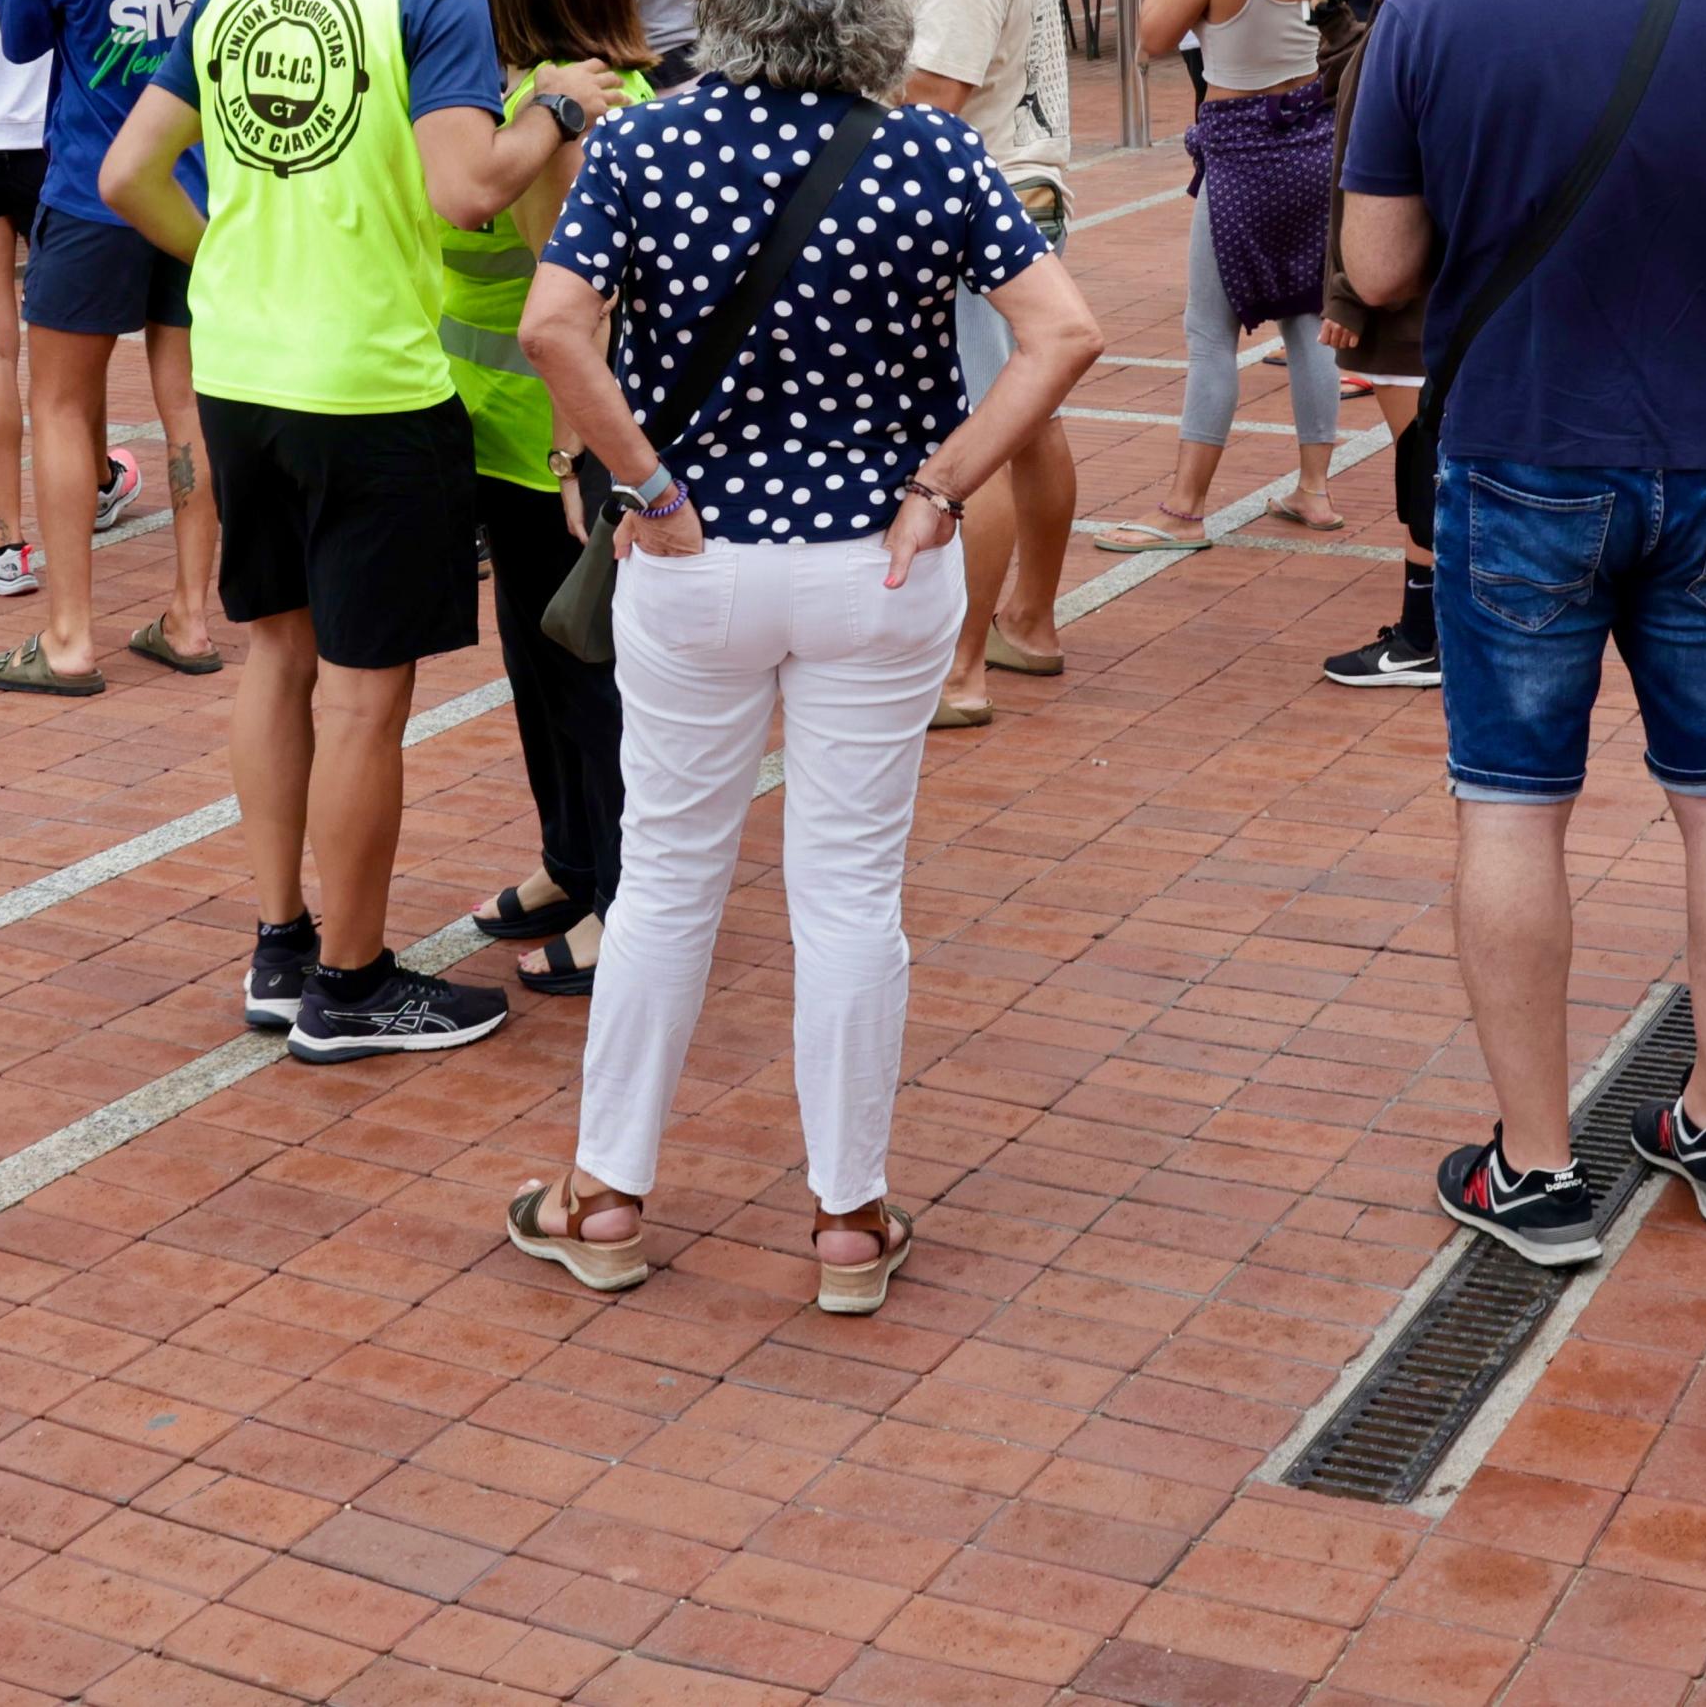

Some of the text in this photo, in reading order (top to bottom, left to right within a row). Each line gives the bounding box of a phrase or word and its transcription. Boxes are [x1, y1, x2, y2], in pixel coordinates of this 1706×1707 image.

[226, 4, 268, 61] UNIÓN
[227, 95, 265, 153] ISLAS
[1545, 1178, 1583, 1193] balance
[1554, 1171, 1574, 1181] new
